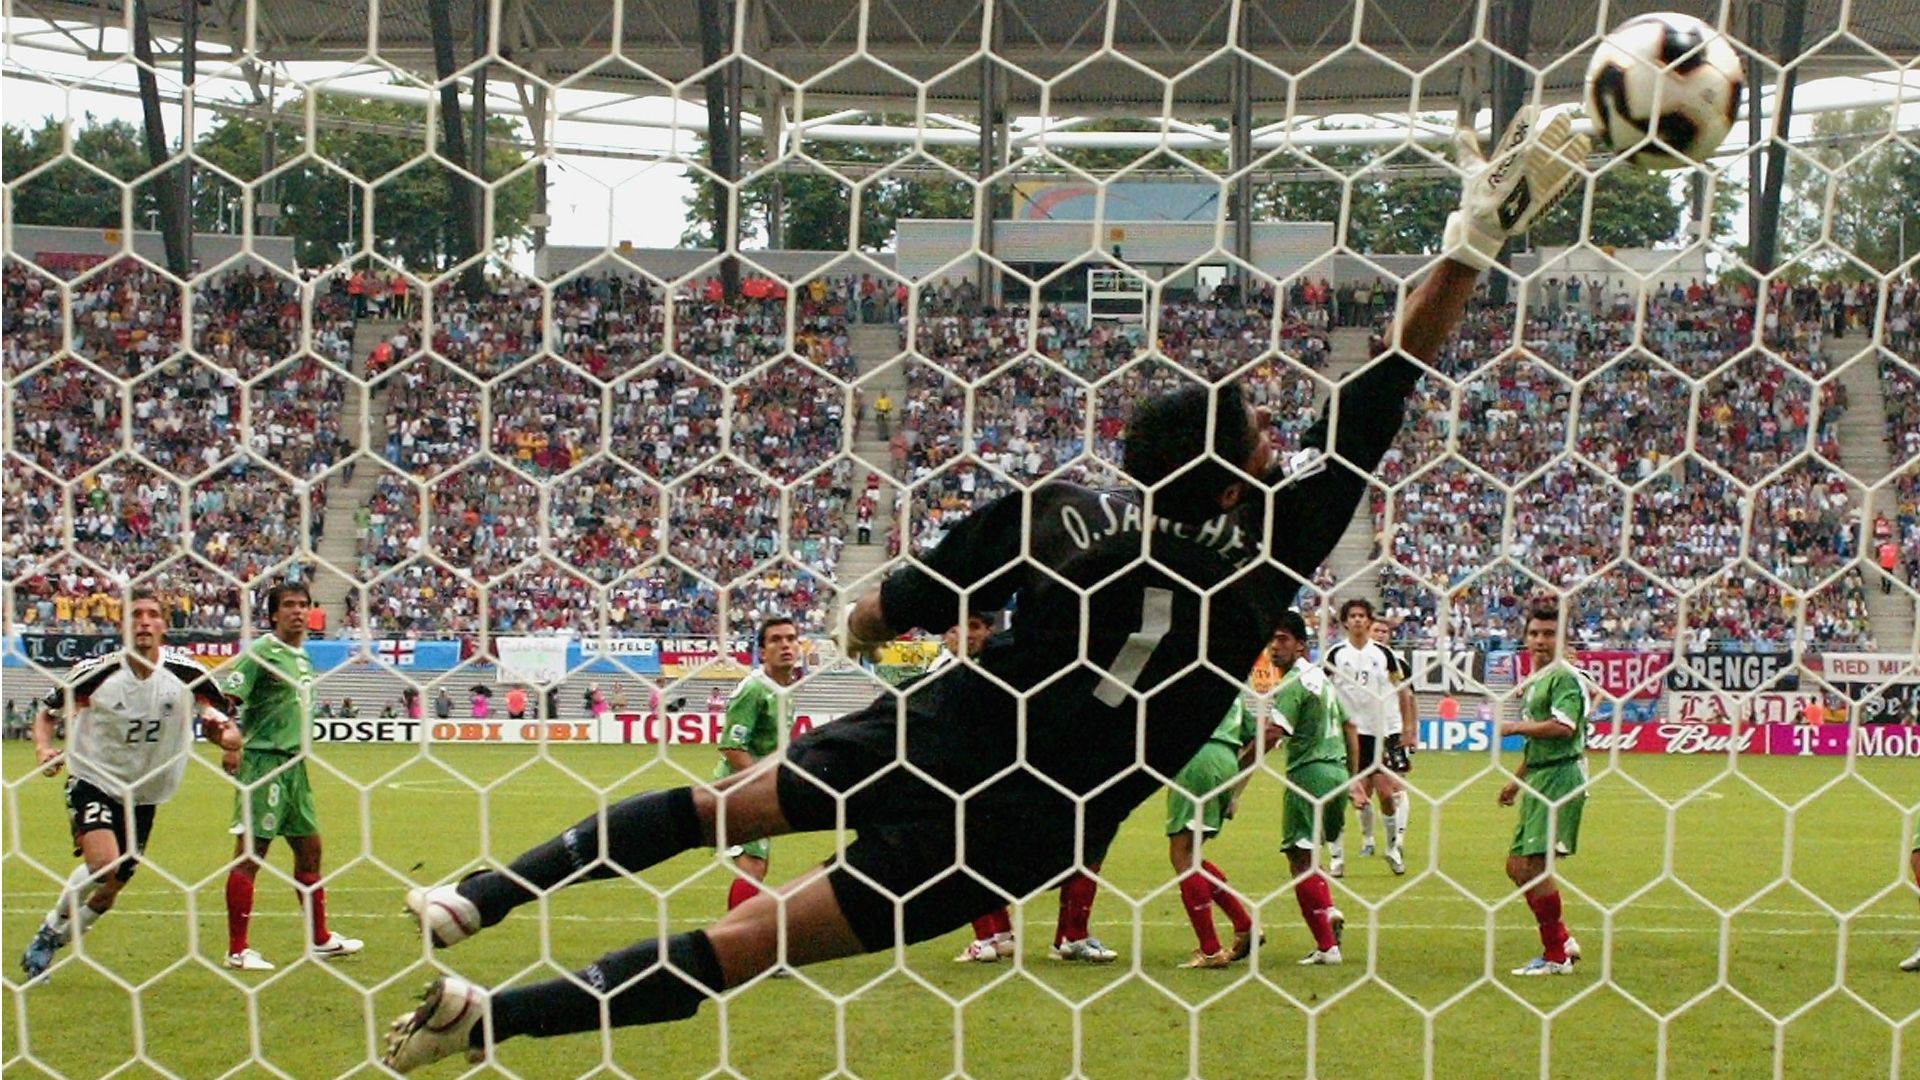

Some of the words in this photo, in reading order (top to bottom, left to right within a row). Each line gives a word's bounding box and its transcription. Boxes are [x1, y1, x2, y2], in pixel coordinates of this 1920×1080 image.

[1834, 660, 1868, 675] RED
[126, 719, 160, 743] 22
[432, 723, 502, 741] OBI
[520, 723, 590, 741] OBI
[1657, 724, 1756, 754] Bud
[268, 782, 280, 807] 8
[84, 801, 113, 824] 22
